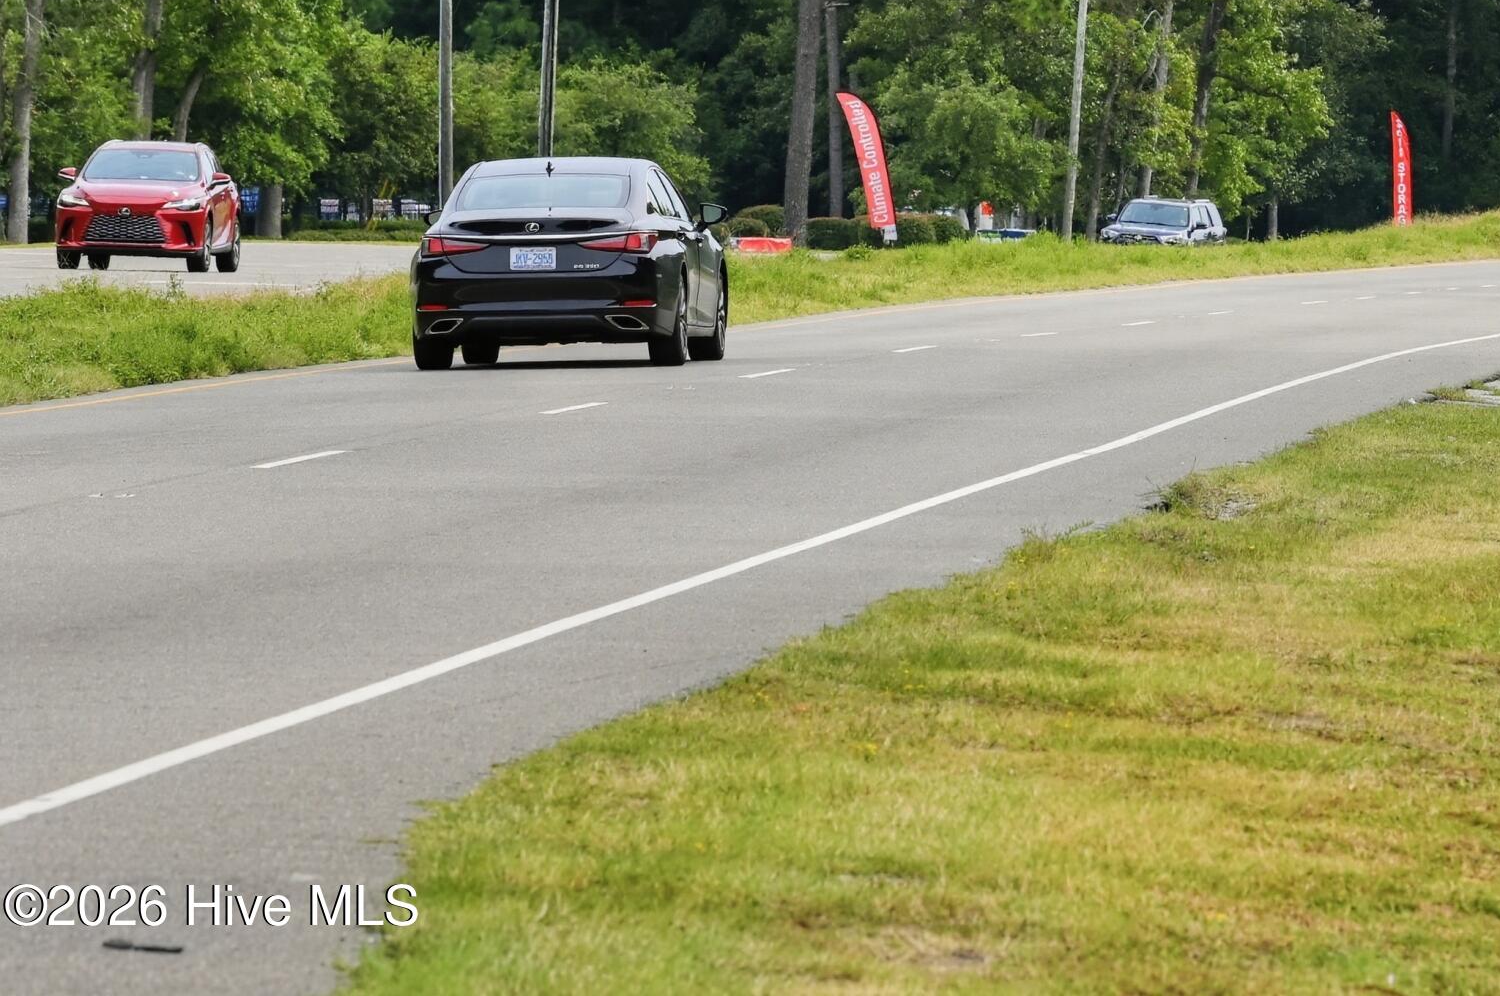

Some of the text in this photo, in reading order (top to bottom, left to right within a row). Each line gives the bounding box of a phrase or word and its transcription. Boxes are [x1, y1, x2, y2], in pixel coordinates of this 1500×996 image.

[846, 100, 888, 223] Climate Controlled
[1397, 162, 1407, 226] STORAG
